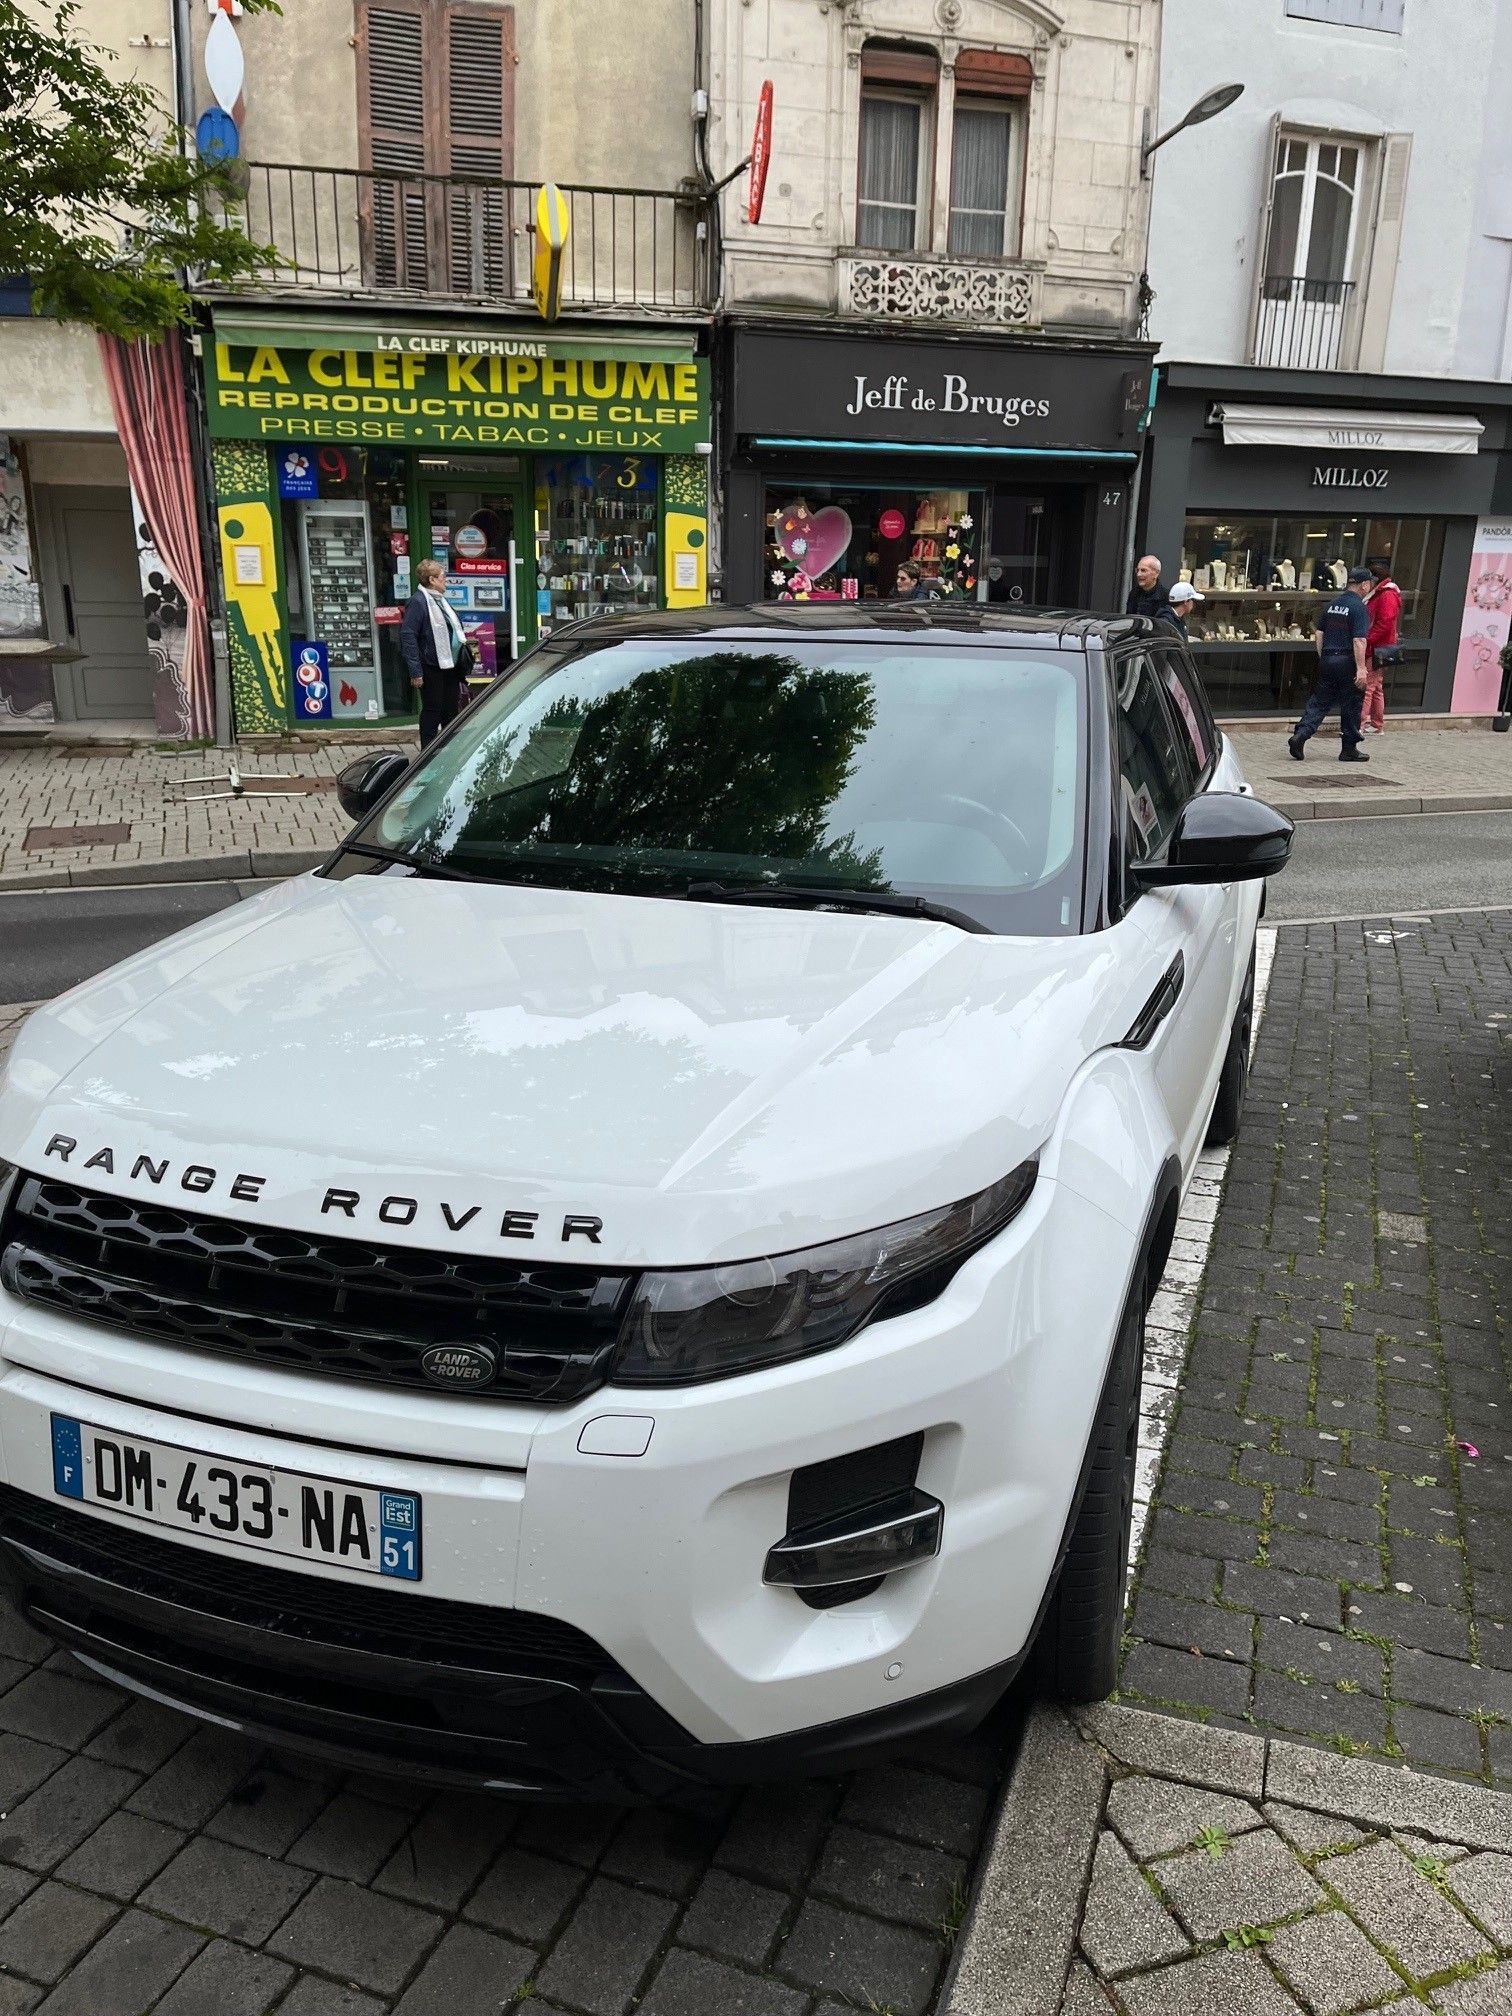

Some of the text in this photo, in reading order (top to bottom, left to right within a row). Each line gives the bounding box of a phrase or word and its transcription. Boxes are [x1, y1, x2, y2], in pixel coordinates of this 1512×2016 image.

[753, 100, 767, 205] TABAC
[377, 335, 547, 357] LA CLEF KIPHUME
[215, 342, 698, 402] LA CLEF KIPHUME
[218, 390, 698, 425] REPRODUCTION DE CLEF
[846, 374, 1050, 427] Jeff de Bruges
[260, 417, 662, 447] PRESSE TABAC JEUX
[1328, 430, 1384, 446] MILLOZ
[617, 457, 642, 488] 3
[1312, 466, 1389, 488] MILLOZ
[1102, 492, 1121, 505] 47
[44, 1133, 604, 1244] RANGE ROVER
[433, 1352, 470, 1367] LAND
[436, 1364, 481, 1379] ROVER
[63, 1465, 74, 1483] F
[94, 1437, 371, 1560] DM-433-NA
[385, 1499, 411, 1510] Grand
[385, 1507, 411, 1524] Est
[383, 1536, 414, 1571] 51
